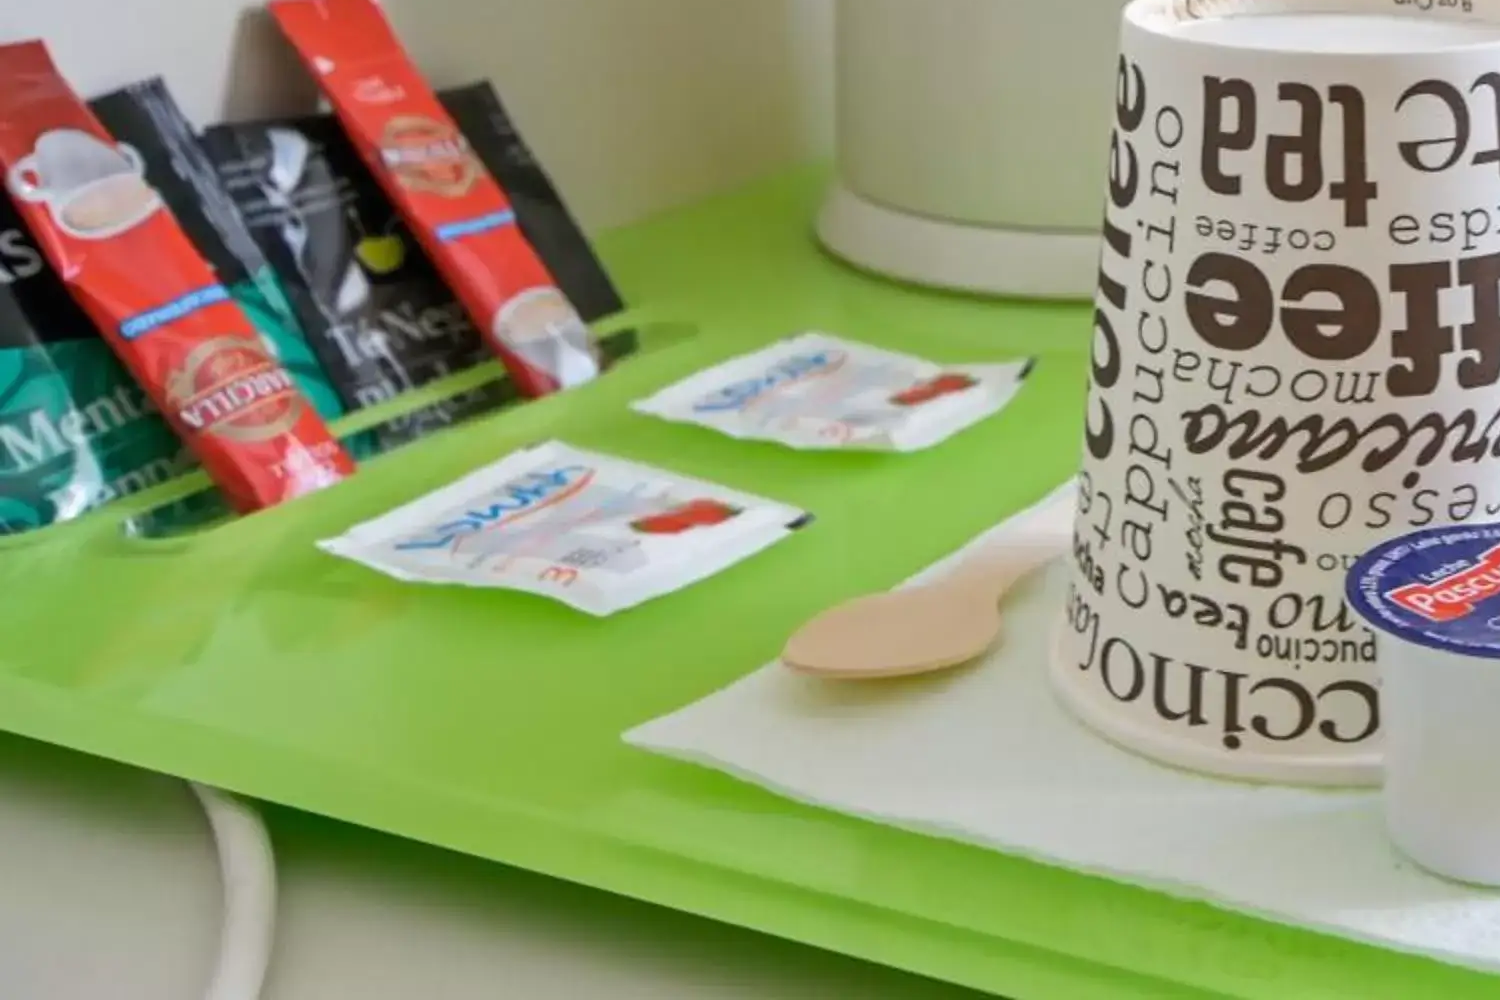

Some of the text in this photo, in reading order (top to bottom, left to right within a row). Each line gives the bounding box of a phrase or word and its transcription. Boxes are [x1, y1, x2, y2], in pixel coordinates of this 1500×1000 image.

[1200, 74, 1378, 229] tea
[1195, 216, 1336, 253] coffee
[1117, 103, 1184, 610] cappuccino
[1172, 346, 1381, 405] mocha
[1205, 467, 1306, 590] cafe
[1157, 582, 1249, 650] tea
[1256, 626, 1378, 670] puccino
[1100, 636, 1380, 750] ccino
